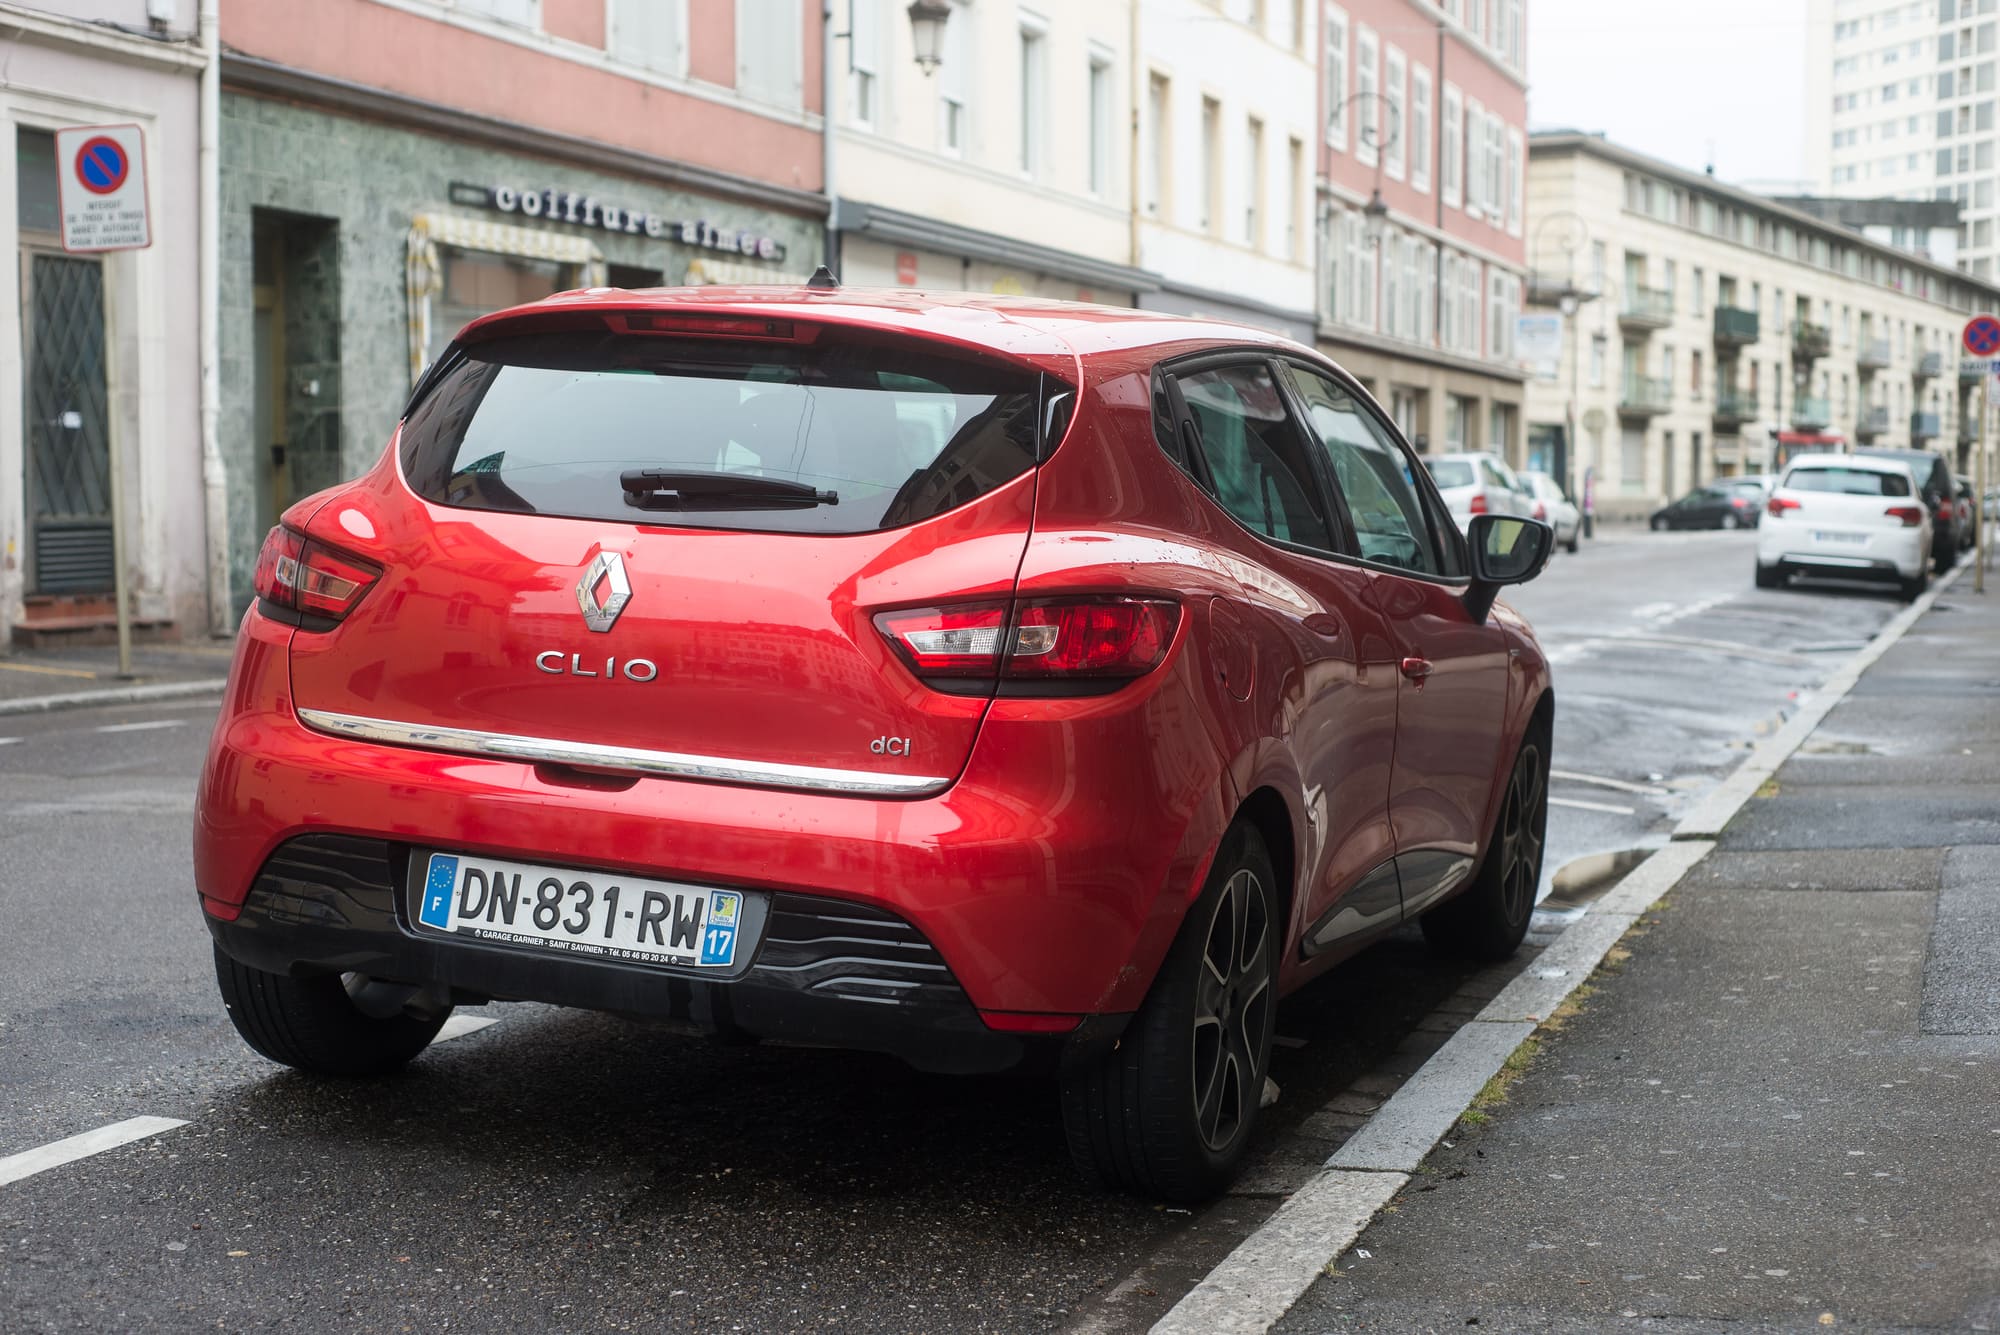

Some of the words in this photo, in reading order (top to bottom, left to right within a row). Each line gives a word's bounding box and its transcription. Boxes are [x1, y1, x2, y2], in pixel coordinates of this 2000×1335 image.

[496, 185, 665, 236] coiffure
[536, 650, 657, 682] CLIO
[432, 896, 442, 912] F
[458, 867, 704, 950] DN-831-RW
[482, 930, 512, 941] GARAGE
[512, 934, 544, 946] GARNIER
[549, 940, 570, 950] SAINT
[571, 943, 604, 954] SAVINIEN
[650, 954, 659, 962] 20
[708, 929, 732, 957] 17
